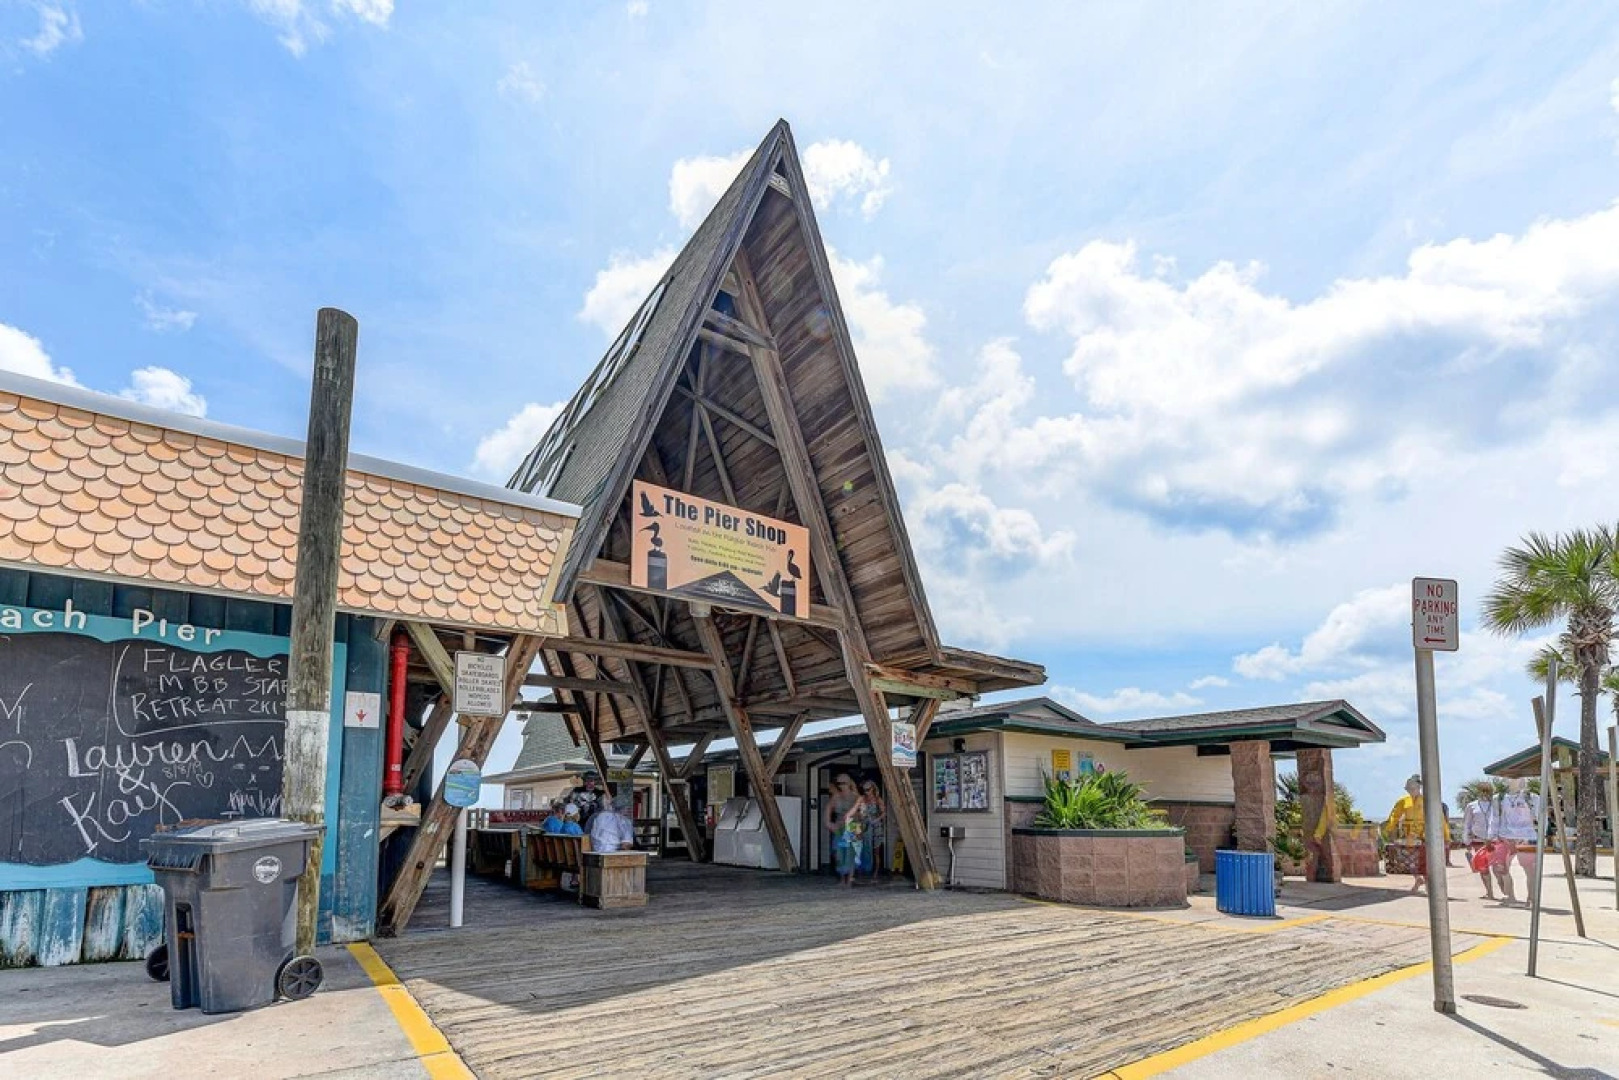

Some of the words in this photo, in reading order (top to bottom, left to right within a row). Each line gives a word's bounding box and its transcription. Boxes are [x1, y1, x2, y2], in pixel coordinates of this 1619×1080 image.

[663, 494, 698, 520] The
[704, 505, 741, 531] Pier
[745, 517, 786, 545] Shop
[1427, 584, 1443, 598] NO
[1413, 600, 1456, 615] PARKING
[1427, 614, 1444, 624] ANY
[132, 608, 222, 645] Pier
[1426, 624, 1445, 635] TIME
[143, 648, 282, 674] FLAGLER
[131, 693, 239, 721] RETREAT
[116, 766, 150, 795] &
